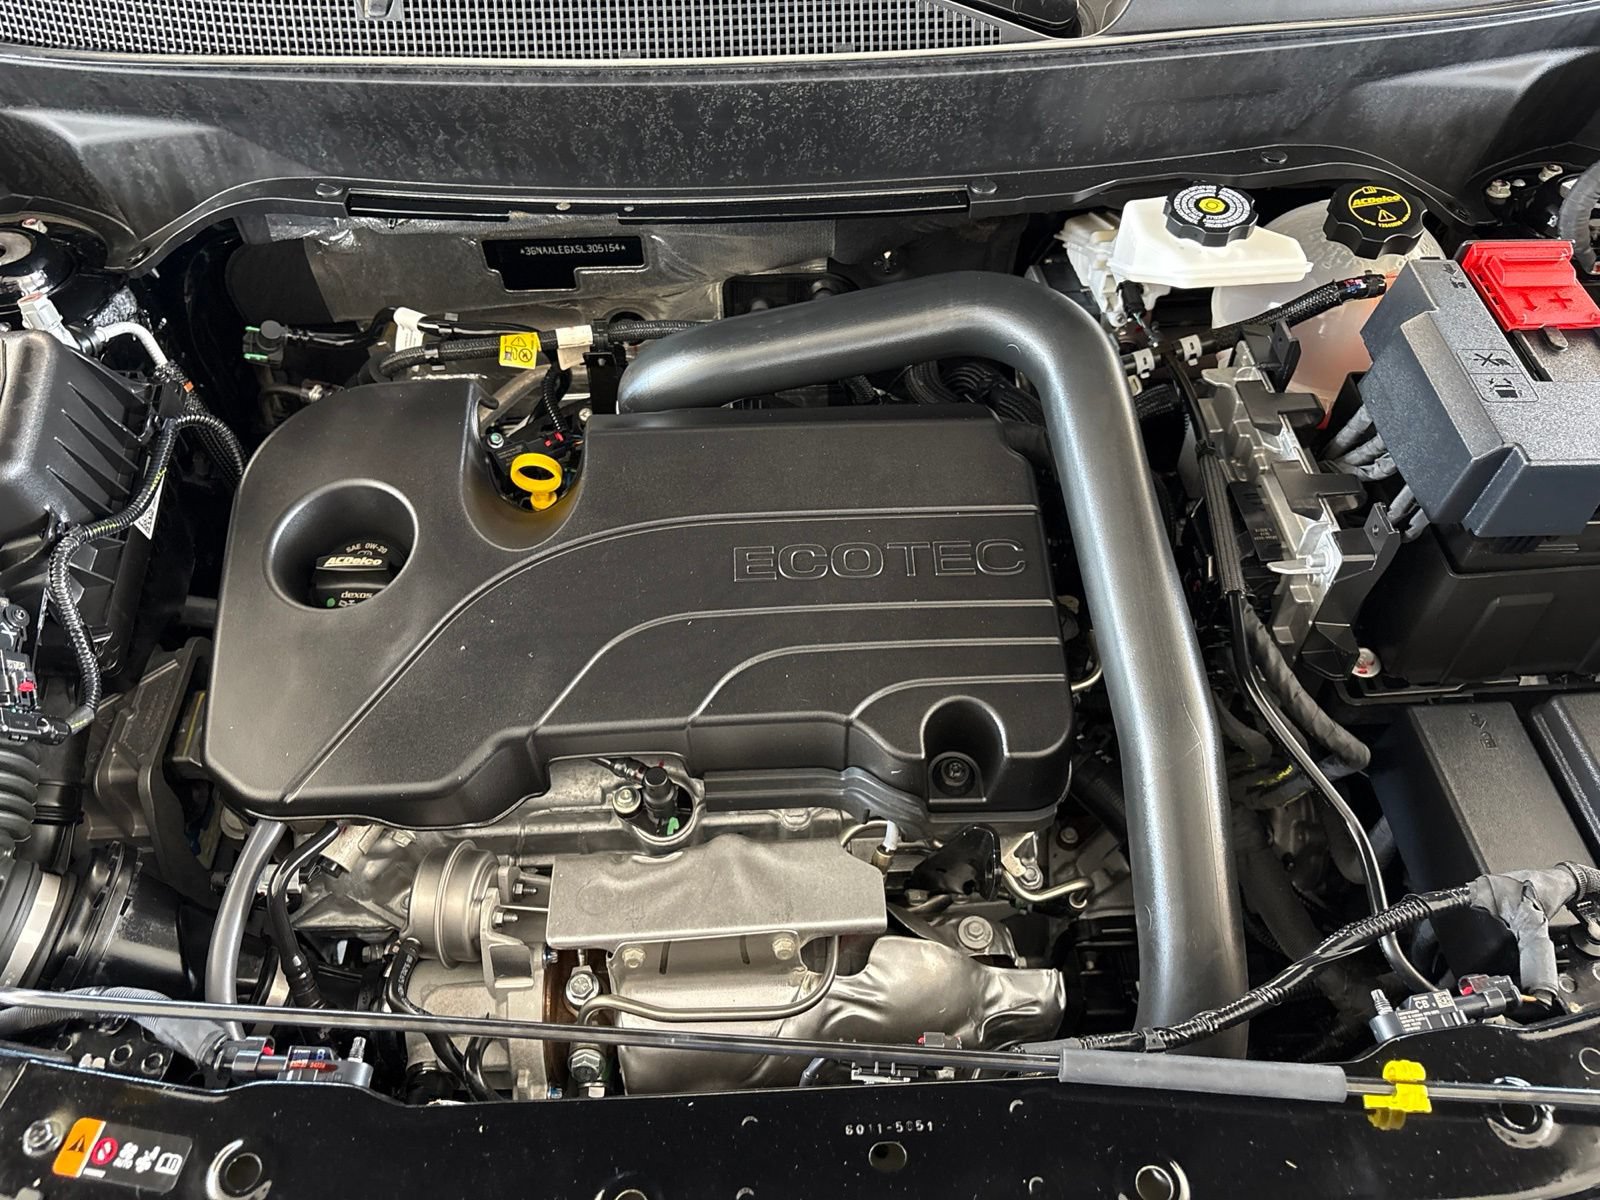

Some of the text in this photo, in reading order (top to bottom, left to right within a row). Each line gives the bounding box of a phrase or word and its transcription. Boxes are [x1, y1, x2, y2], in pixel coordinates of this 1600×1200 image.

[345, 542, 388, 554] SAE 0W-20
[323, 556, 383, 568] ACDelco
[733, 539, 1026, 582] ECOTEC
[340, 590, 373, 599] dexos
[1414, 1000, 1431, 1010] CB
